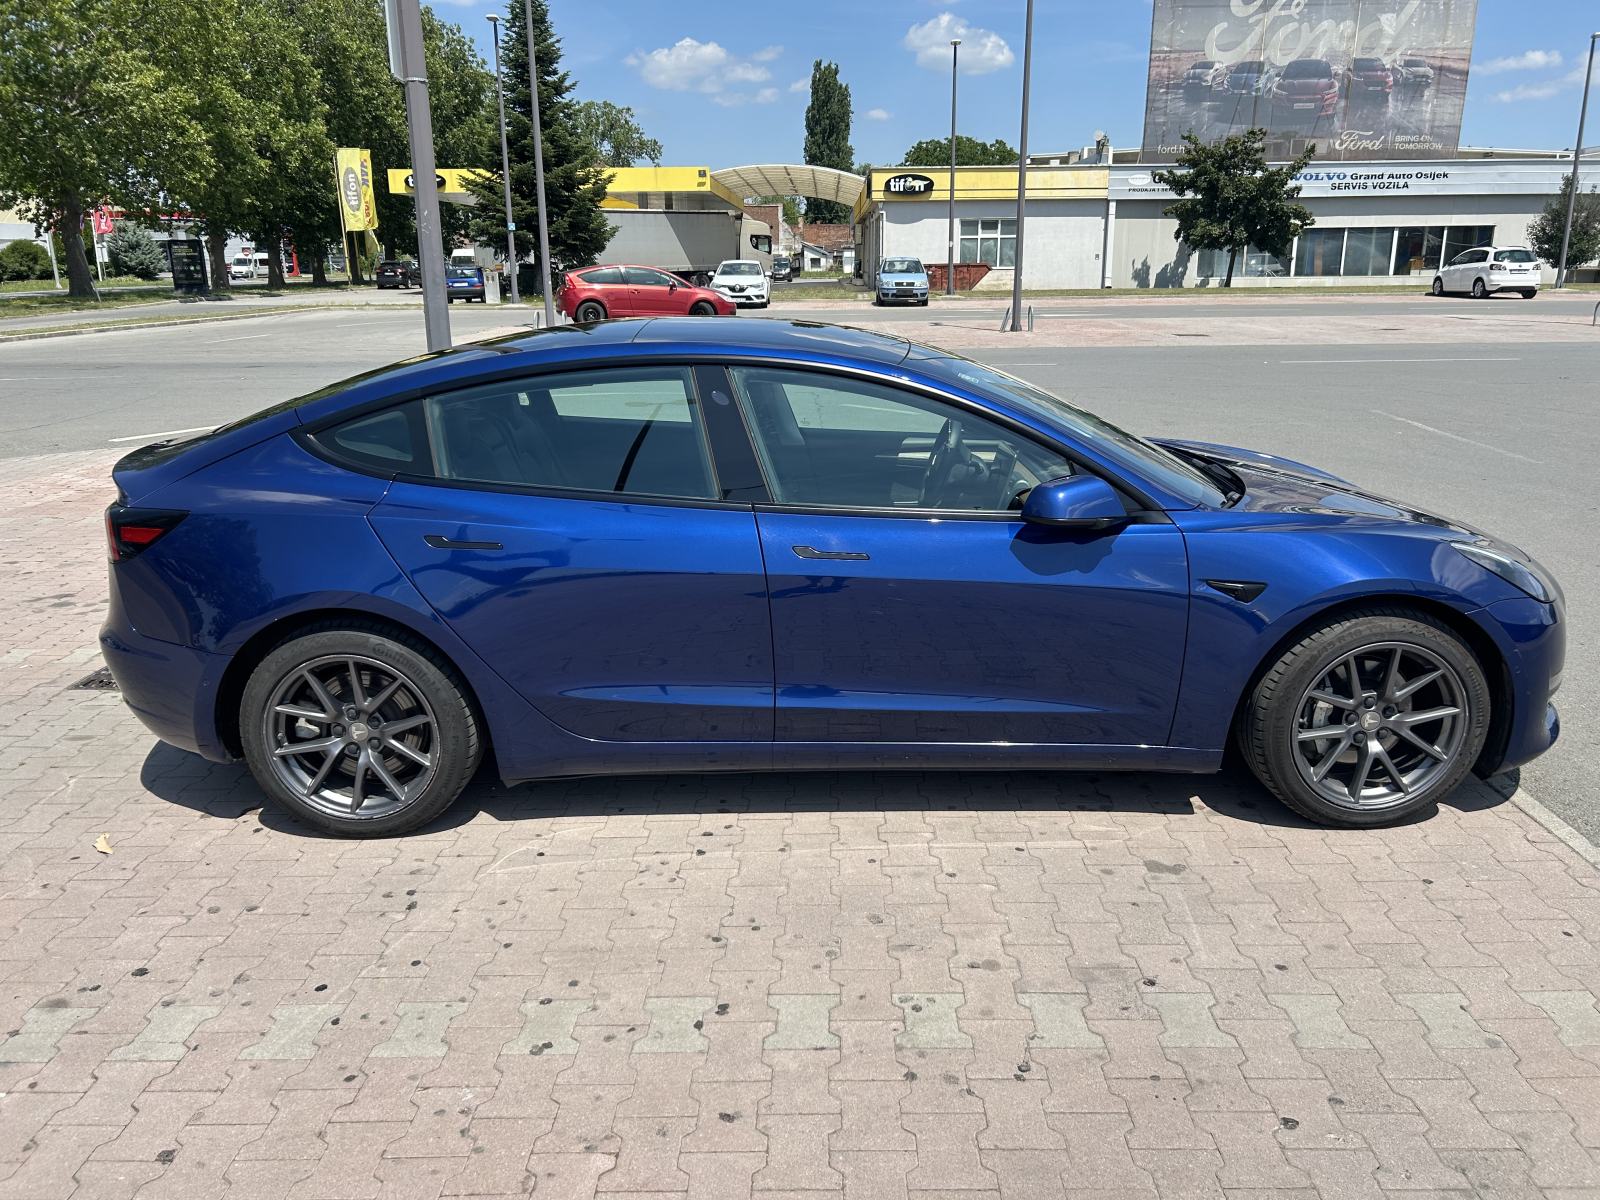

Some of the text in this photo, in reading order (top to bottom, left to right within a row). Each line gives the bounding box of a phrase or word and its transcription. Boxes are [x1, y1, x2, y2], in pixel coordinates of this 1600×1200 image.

[1204, 0, 1422, 67] Ford
[1335, 130, 1384, 150] Ford
[1158, 145, 1185, 154] ford.h
[1290, 172, 1347, 181] VOLVO
[1350, 173, 1384, 181] Grand
[1415, 171, 1449, 181] Osijek
[347, 173, 359, 206] tifon
[890, 177, 930, 191] tifon
[1330, 181, 1409, 191] SERVIS VOZILA
